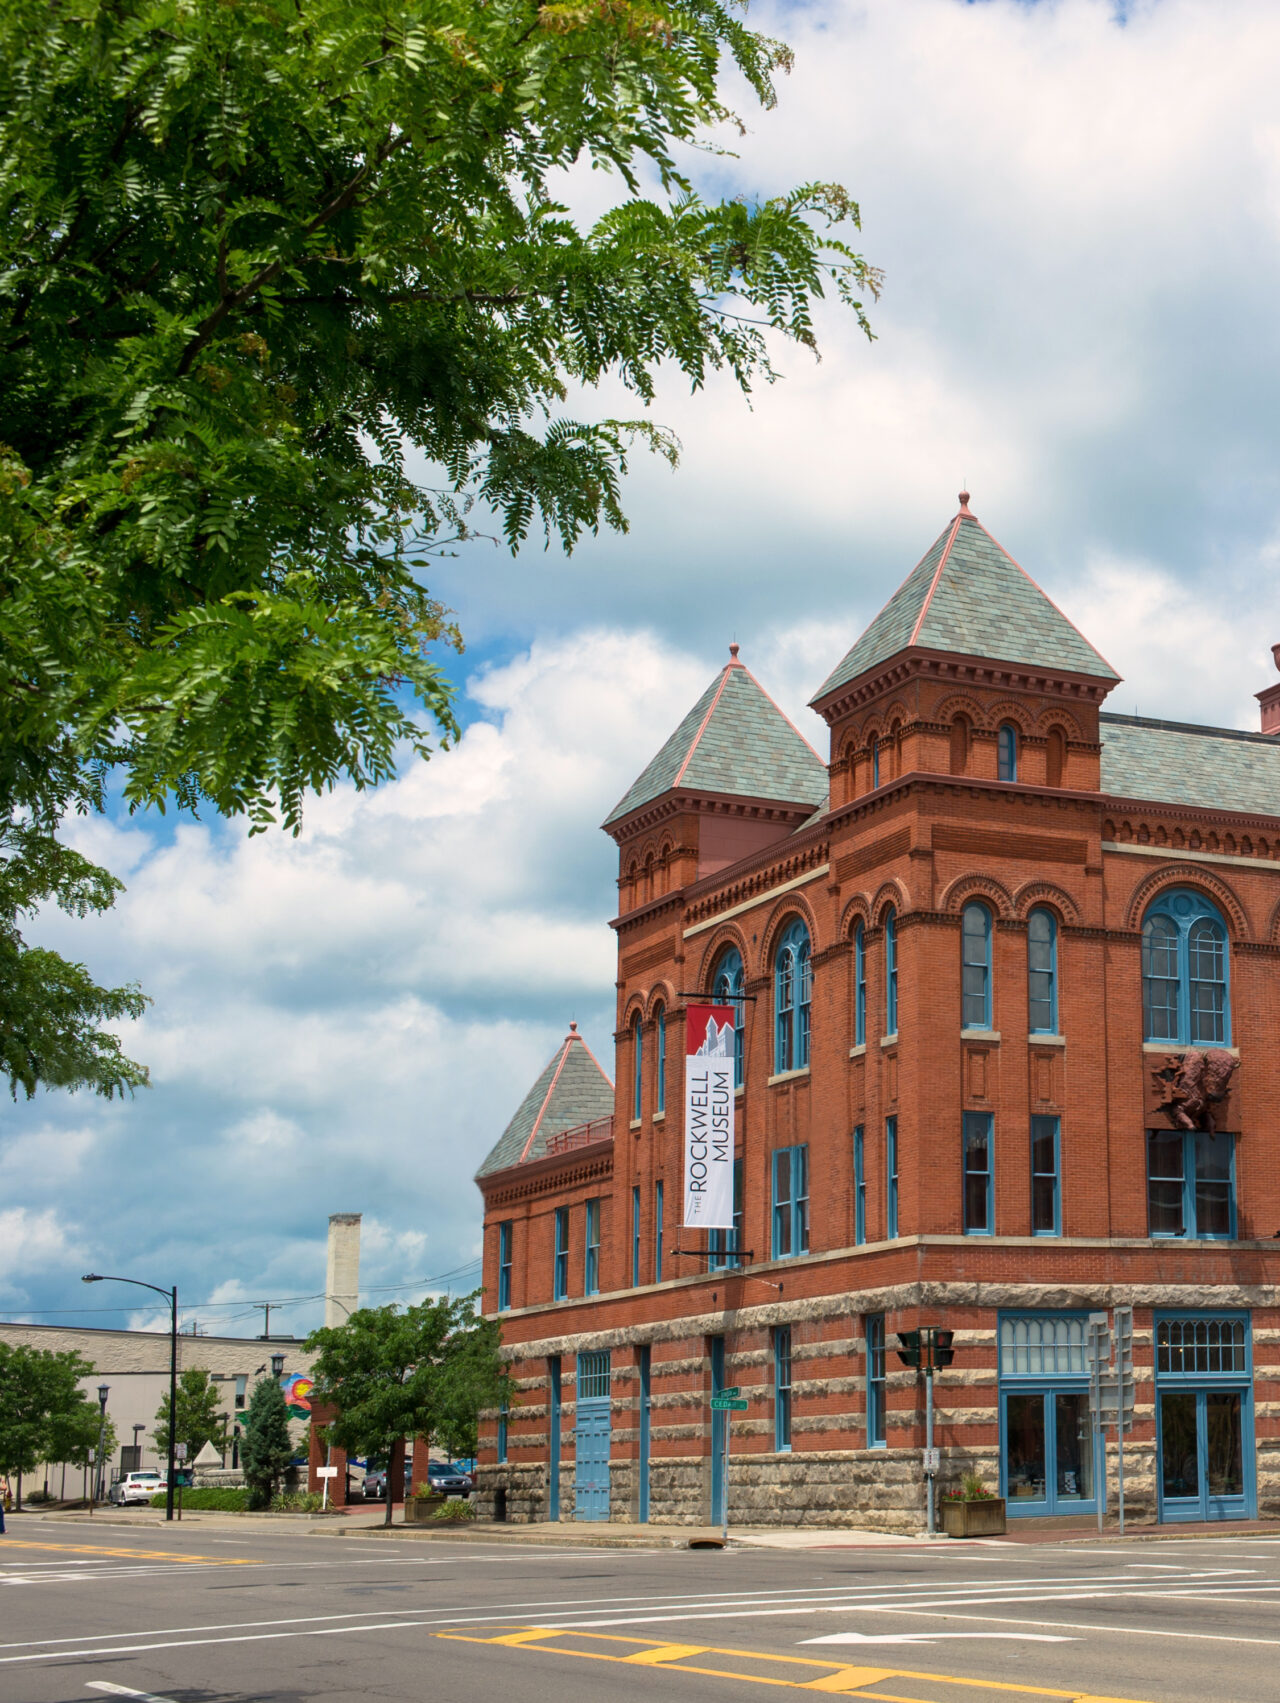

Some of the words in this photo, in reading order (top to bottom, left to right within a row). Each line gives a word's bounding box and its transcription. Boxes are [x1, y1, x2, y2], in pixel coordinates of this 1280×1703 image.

[690, 1070, 709, 1193] ROCKWELL
[712, 1072, 729, 1163] MUSEUM
[694, 1195, 702, 1214] THE
